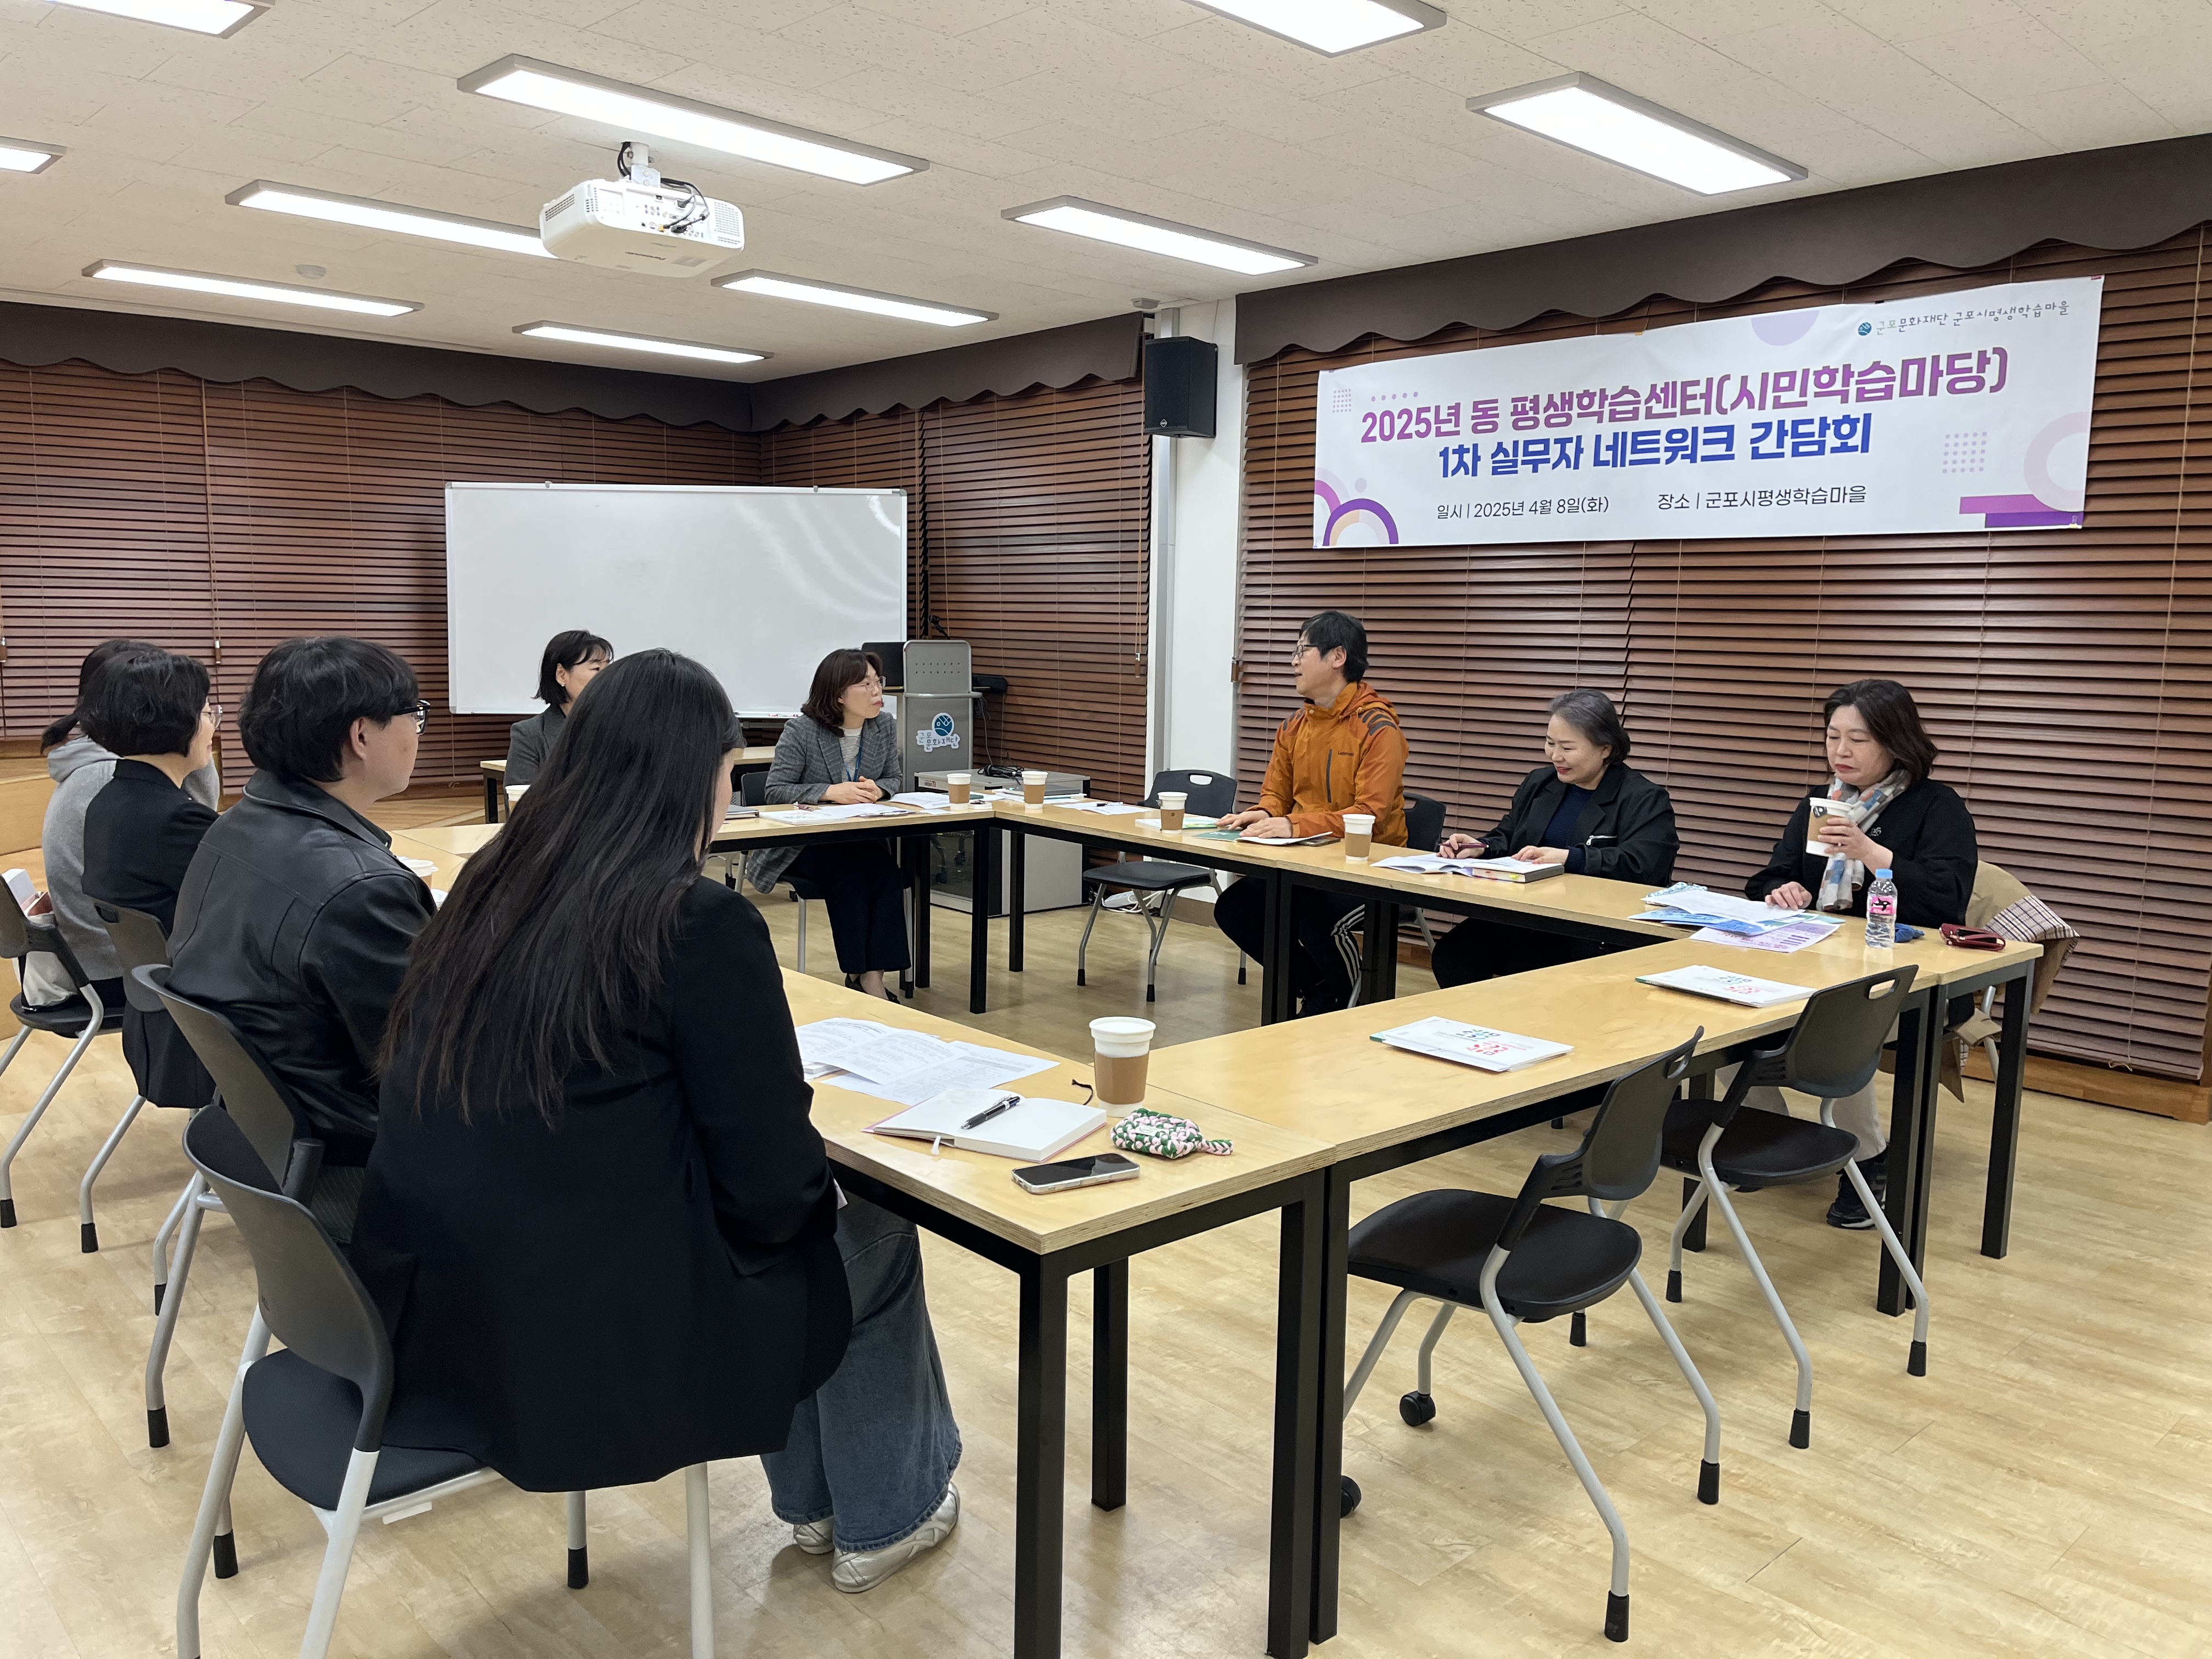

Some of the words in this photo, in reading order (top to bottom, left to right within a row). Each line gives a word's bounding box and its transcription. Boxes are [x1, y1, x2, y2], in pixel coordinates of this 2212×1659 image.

[1876, 313, 1949, 335] 군포문화재단
[1953, 300, 2070, 326] 군포시평생학습마을
[1361, 402, 1461, 443] 2025년
[1471, 398, 1500, 435] 동
[1510, 347, 2008, 431] 평생학습센터(시민학습마당)
[1439, 443, 1481, 479] 1차
[1491, 435, 1584, 476] 실무자
[1593, 424, 1735, 467] 네트워크
[1750, 413, 1872, 460] 간담회
[1437, 504, 1462, 519] 일시
[1474, 500, 1525, 518] 2025년
[1528, 499, 1552, 515] 4월
[1556, 496, 1609, 514] 8일(화)
[1658, 493, 1690, 510] 장소
[1706, 485, 1867, 509] 군포시평생학습마을
[926, 736, 958, 750] 문화재단
